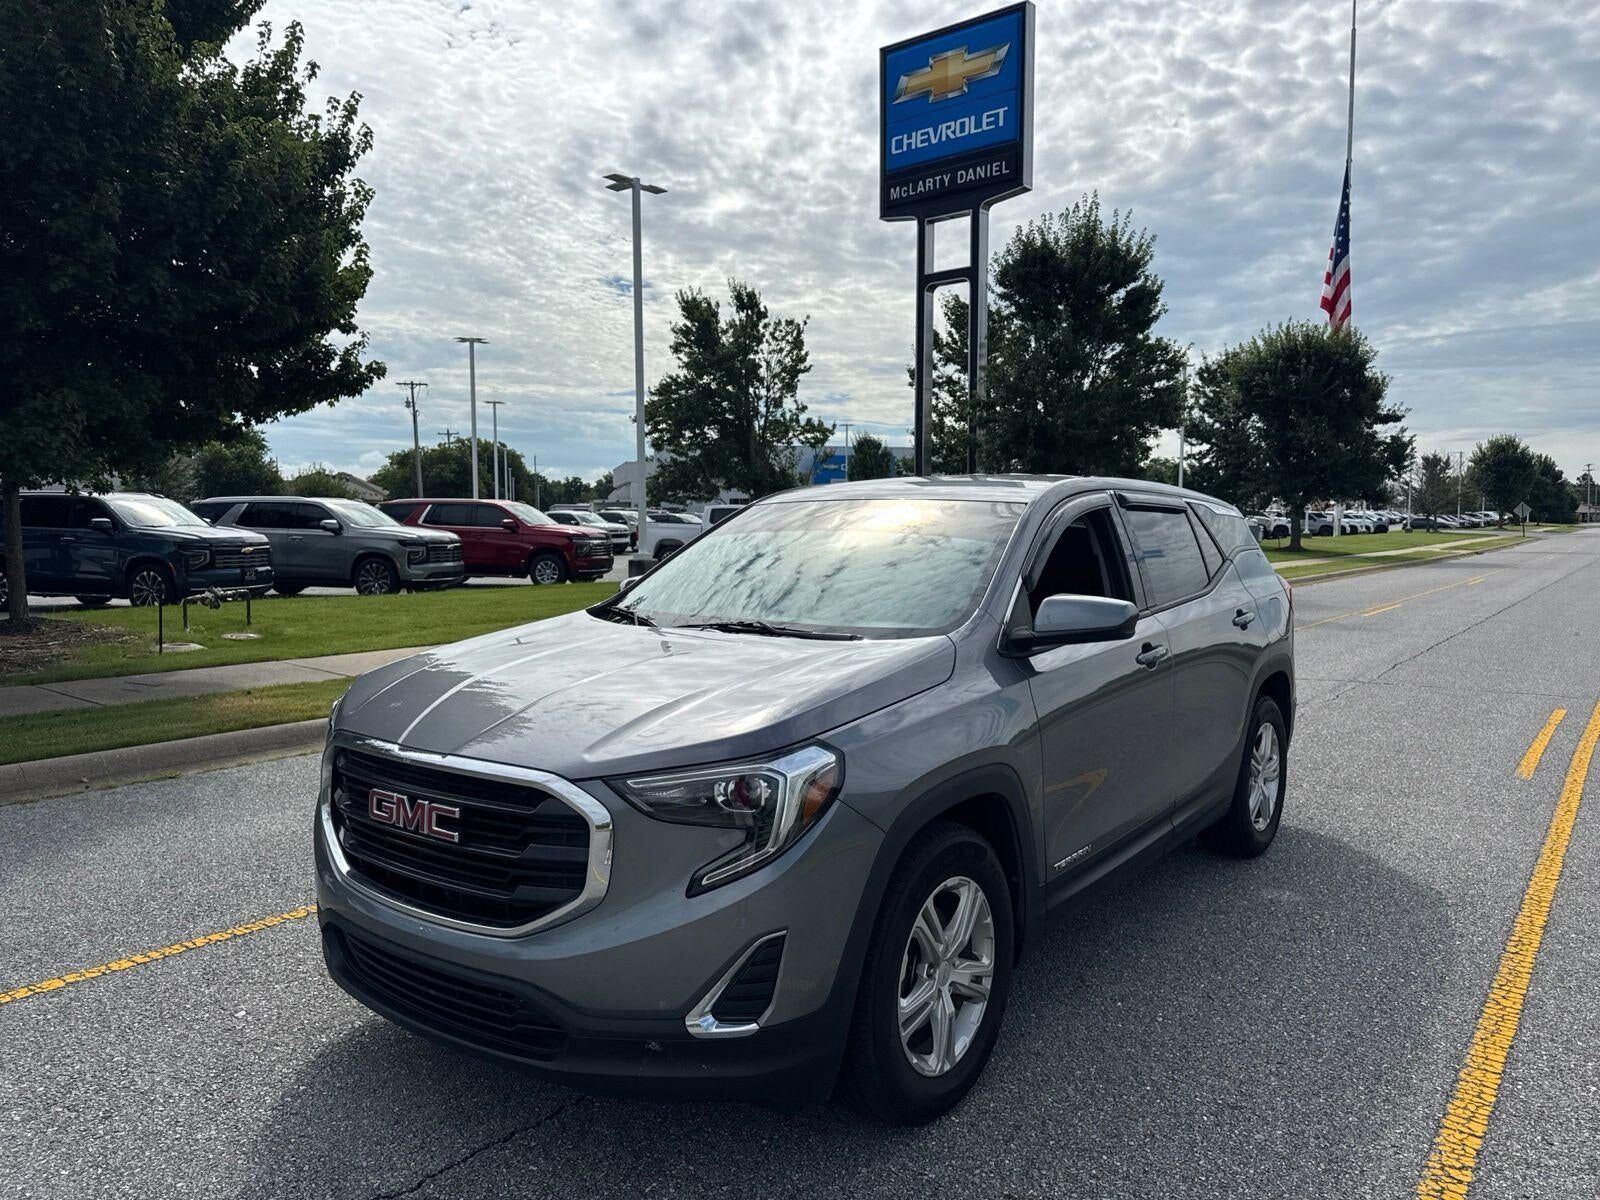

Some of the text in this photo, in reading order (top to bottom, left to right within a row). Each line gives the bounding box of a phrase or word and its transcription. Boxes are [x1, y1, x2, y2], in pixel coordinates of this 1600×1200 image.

[891, 106, 1008, 155] CHEVROLET
[890, 160, 1010, 200] McLARTY DANIEL
[368, 788, 460, 843] GMC
